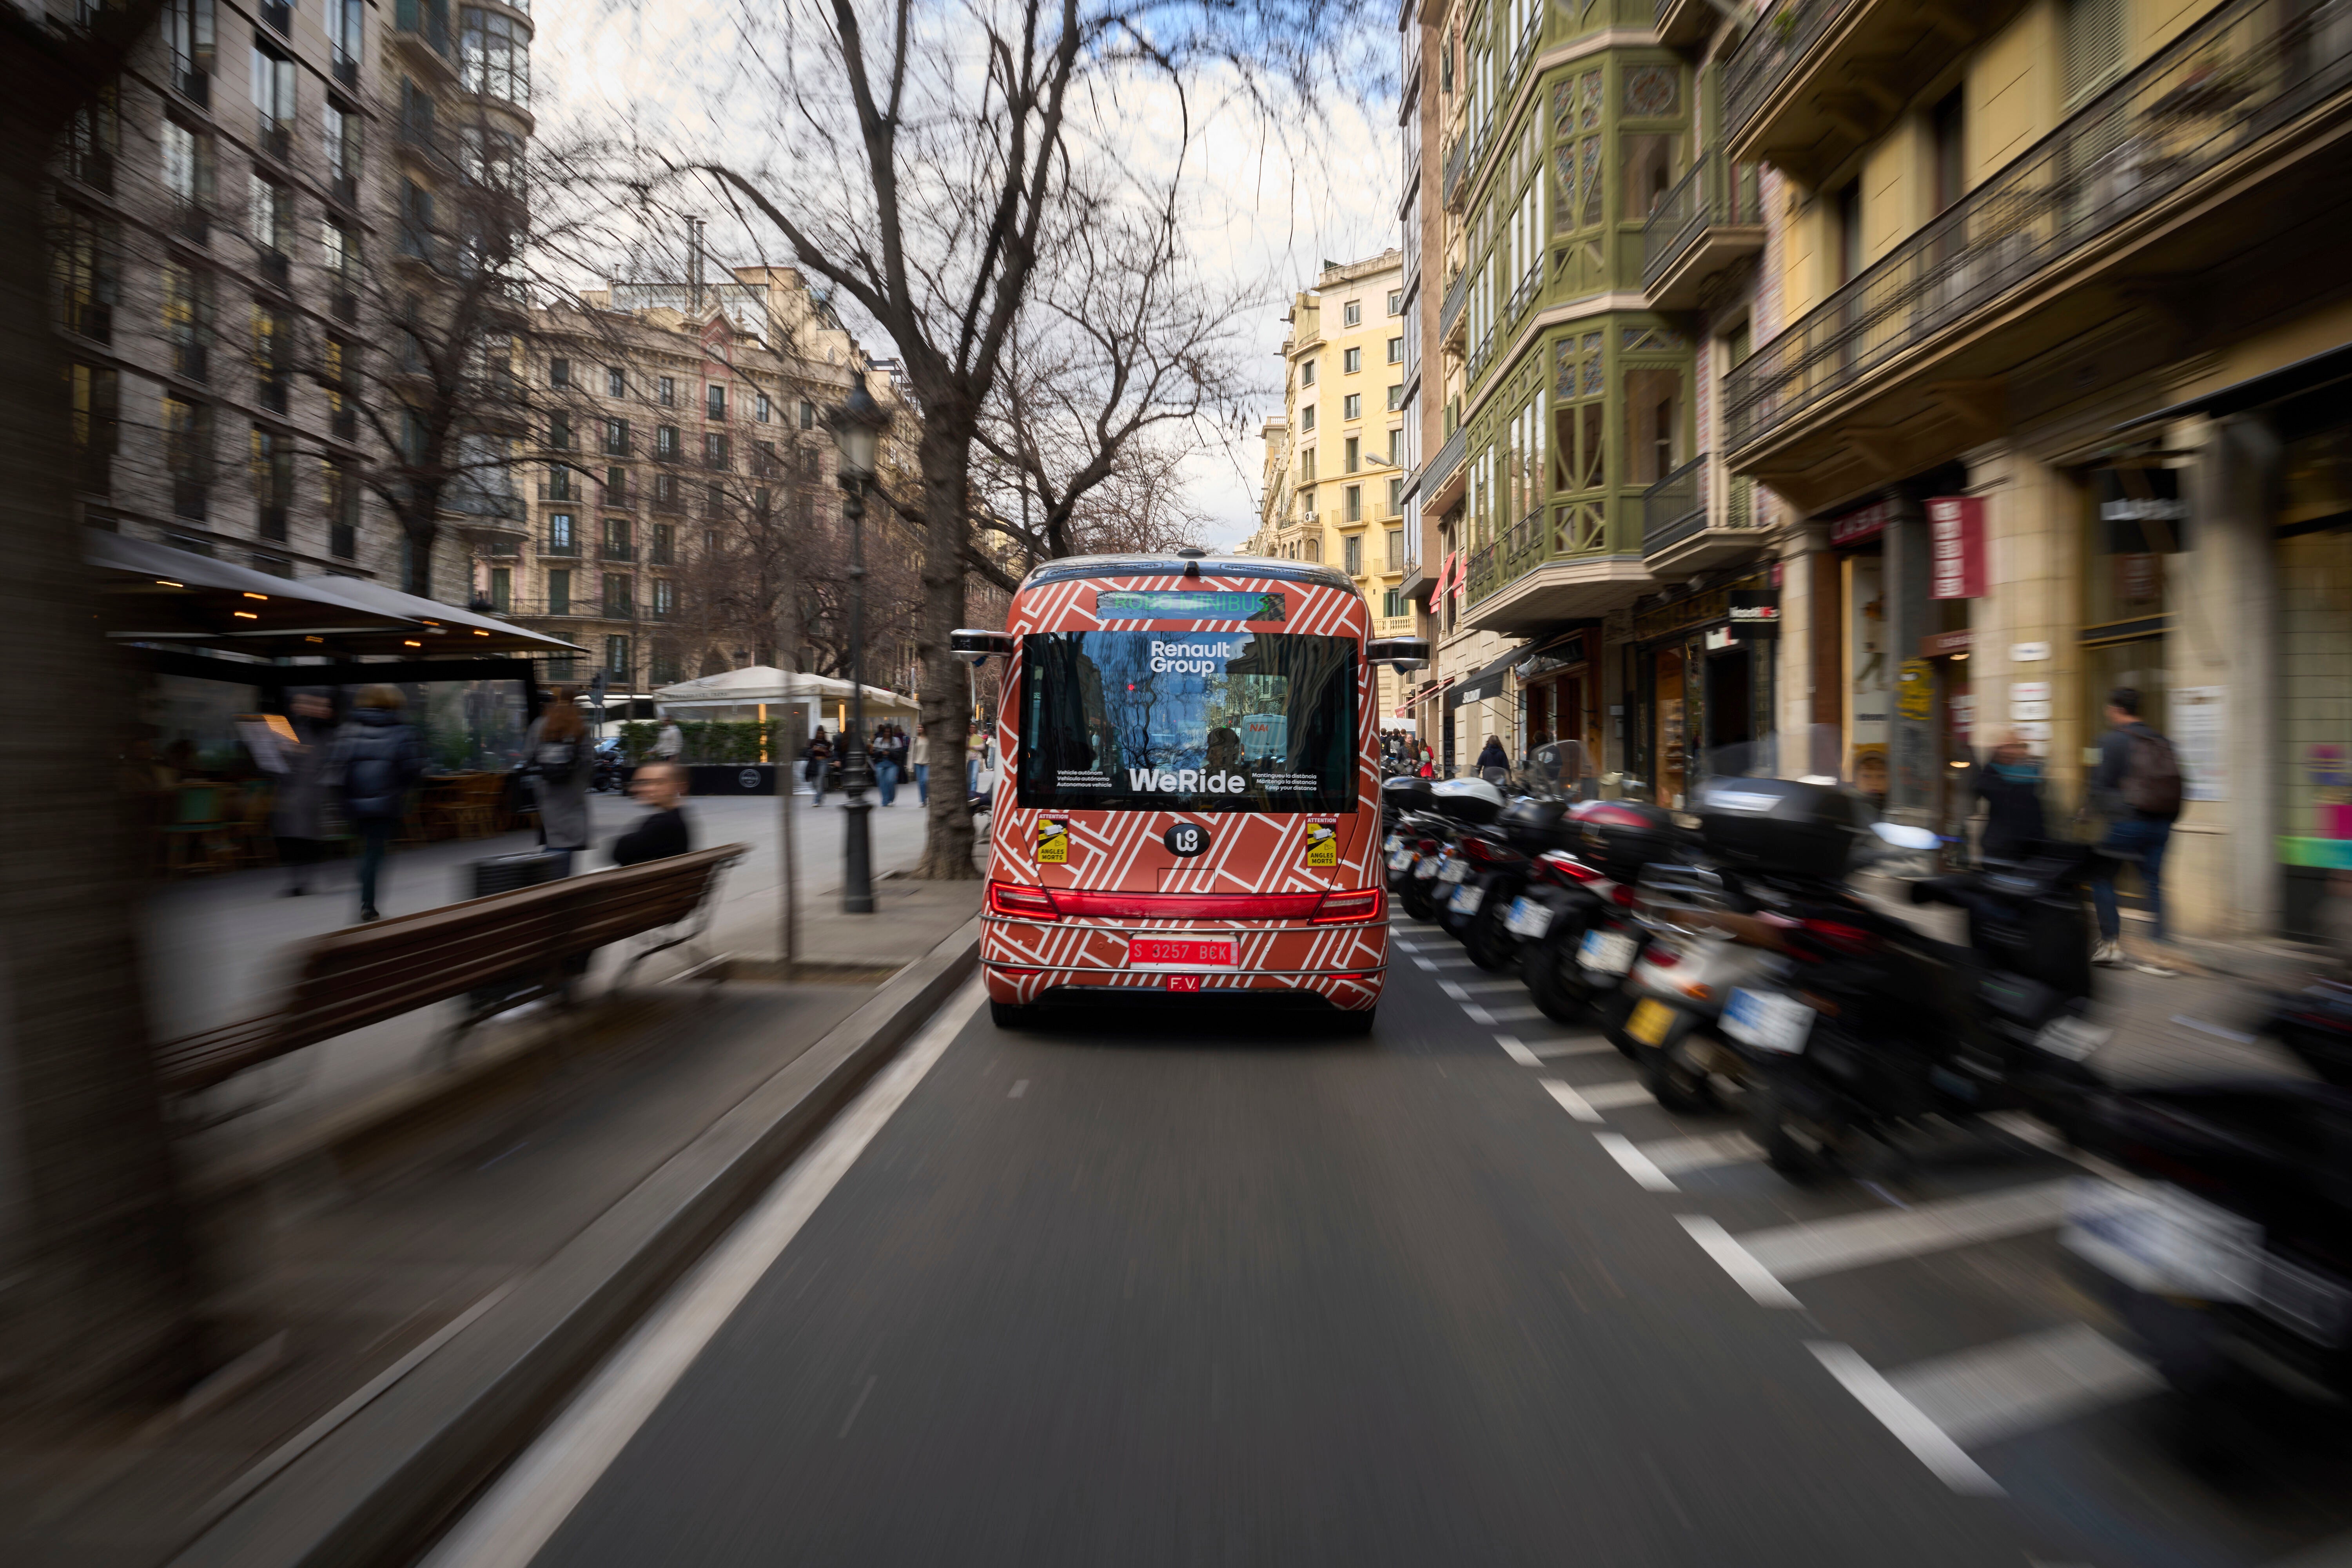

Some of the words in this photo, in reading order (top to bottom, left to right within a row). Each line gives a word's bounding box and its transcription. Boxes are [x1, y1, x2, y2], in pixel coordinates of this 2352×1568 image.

[1115, 593, 1172, 610] ROBO
[1180, 595, 1269, 612] MINIBUS
[1151, 641, 1230, 657] Renault
[1150, 657, 1215, 677] Group
[1129, 768, 1245, 793] WeRide
[1134, 944, 1142, 957] S
[1152, 944, 1189, 958] 3257
[1200, 945, 1227, 960] BCK
